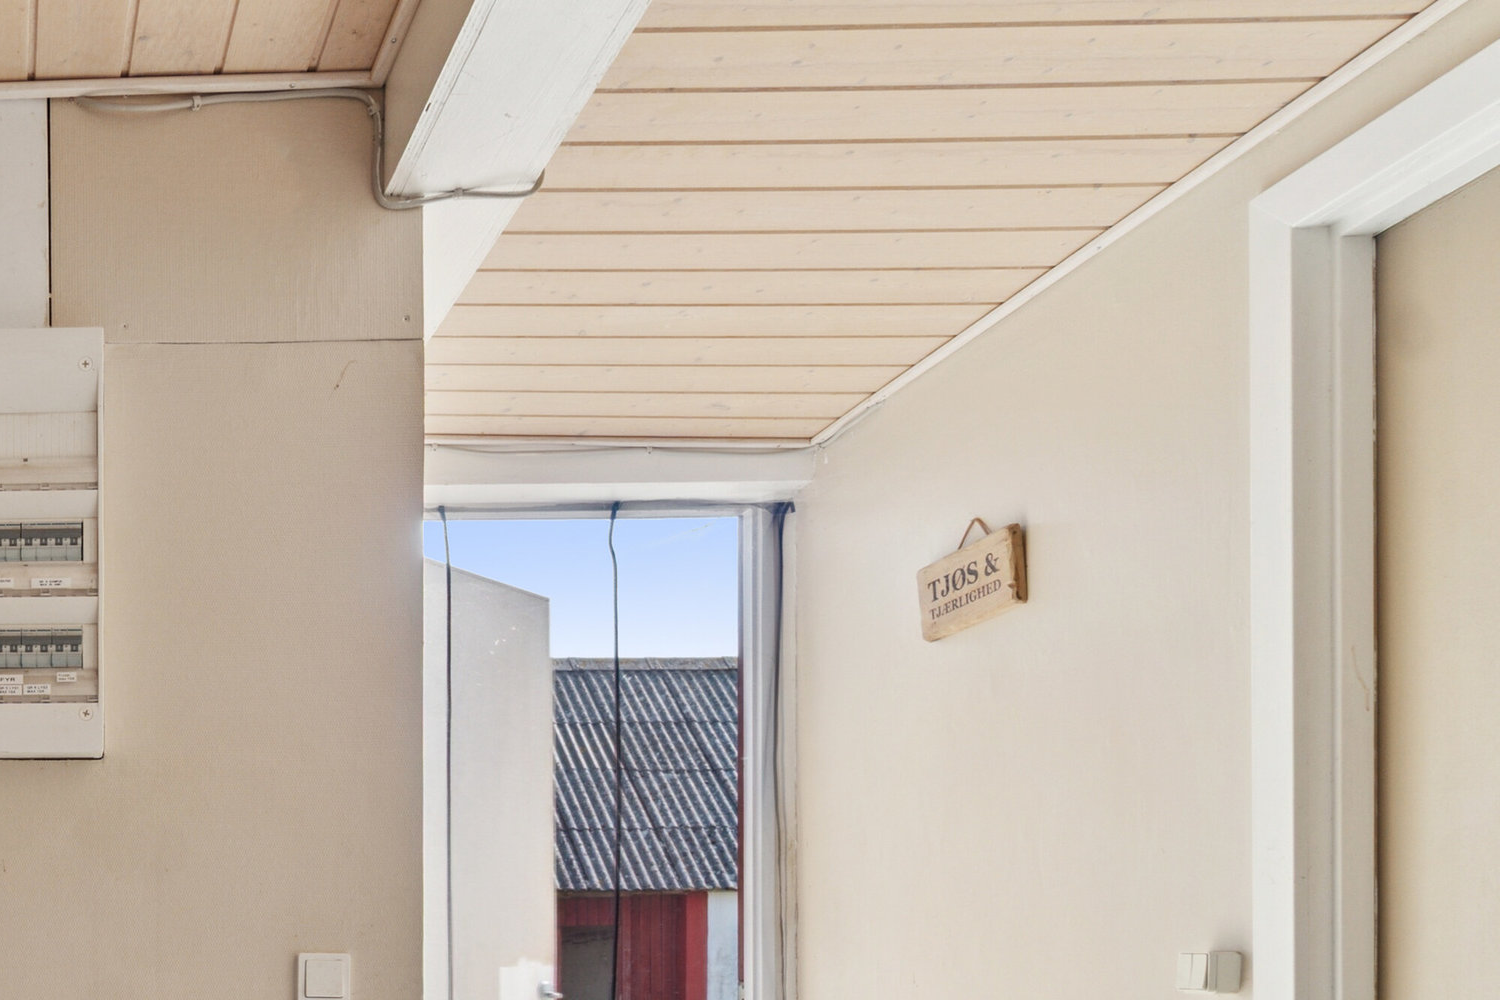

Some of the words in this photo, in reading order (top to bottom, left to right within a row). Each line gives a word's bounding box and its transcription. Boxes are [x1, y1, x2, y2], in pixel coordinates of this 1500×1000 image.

[927, 561, 979, 602] TJØS
[984, 552, 1000, 577] &
[929, 579, 1002, 620] TJÆRLIGHED
